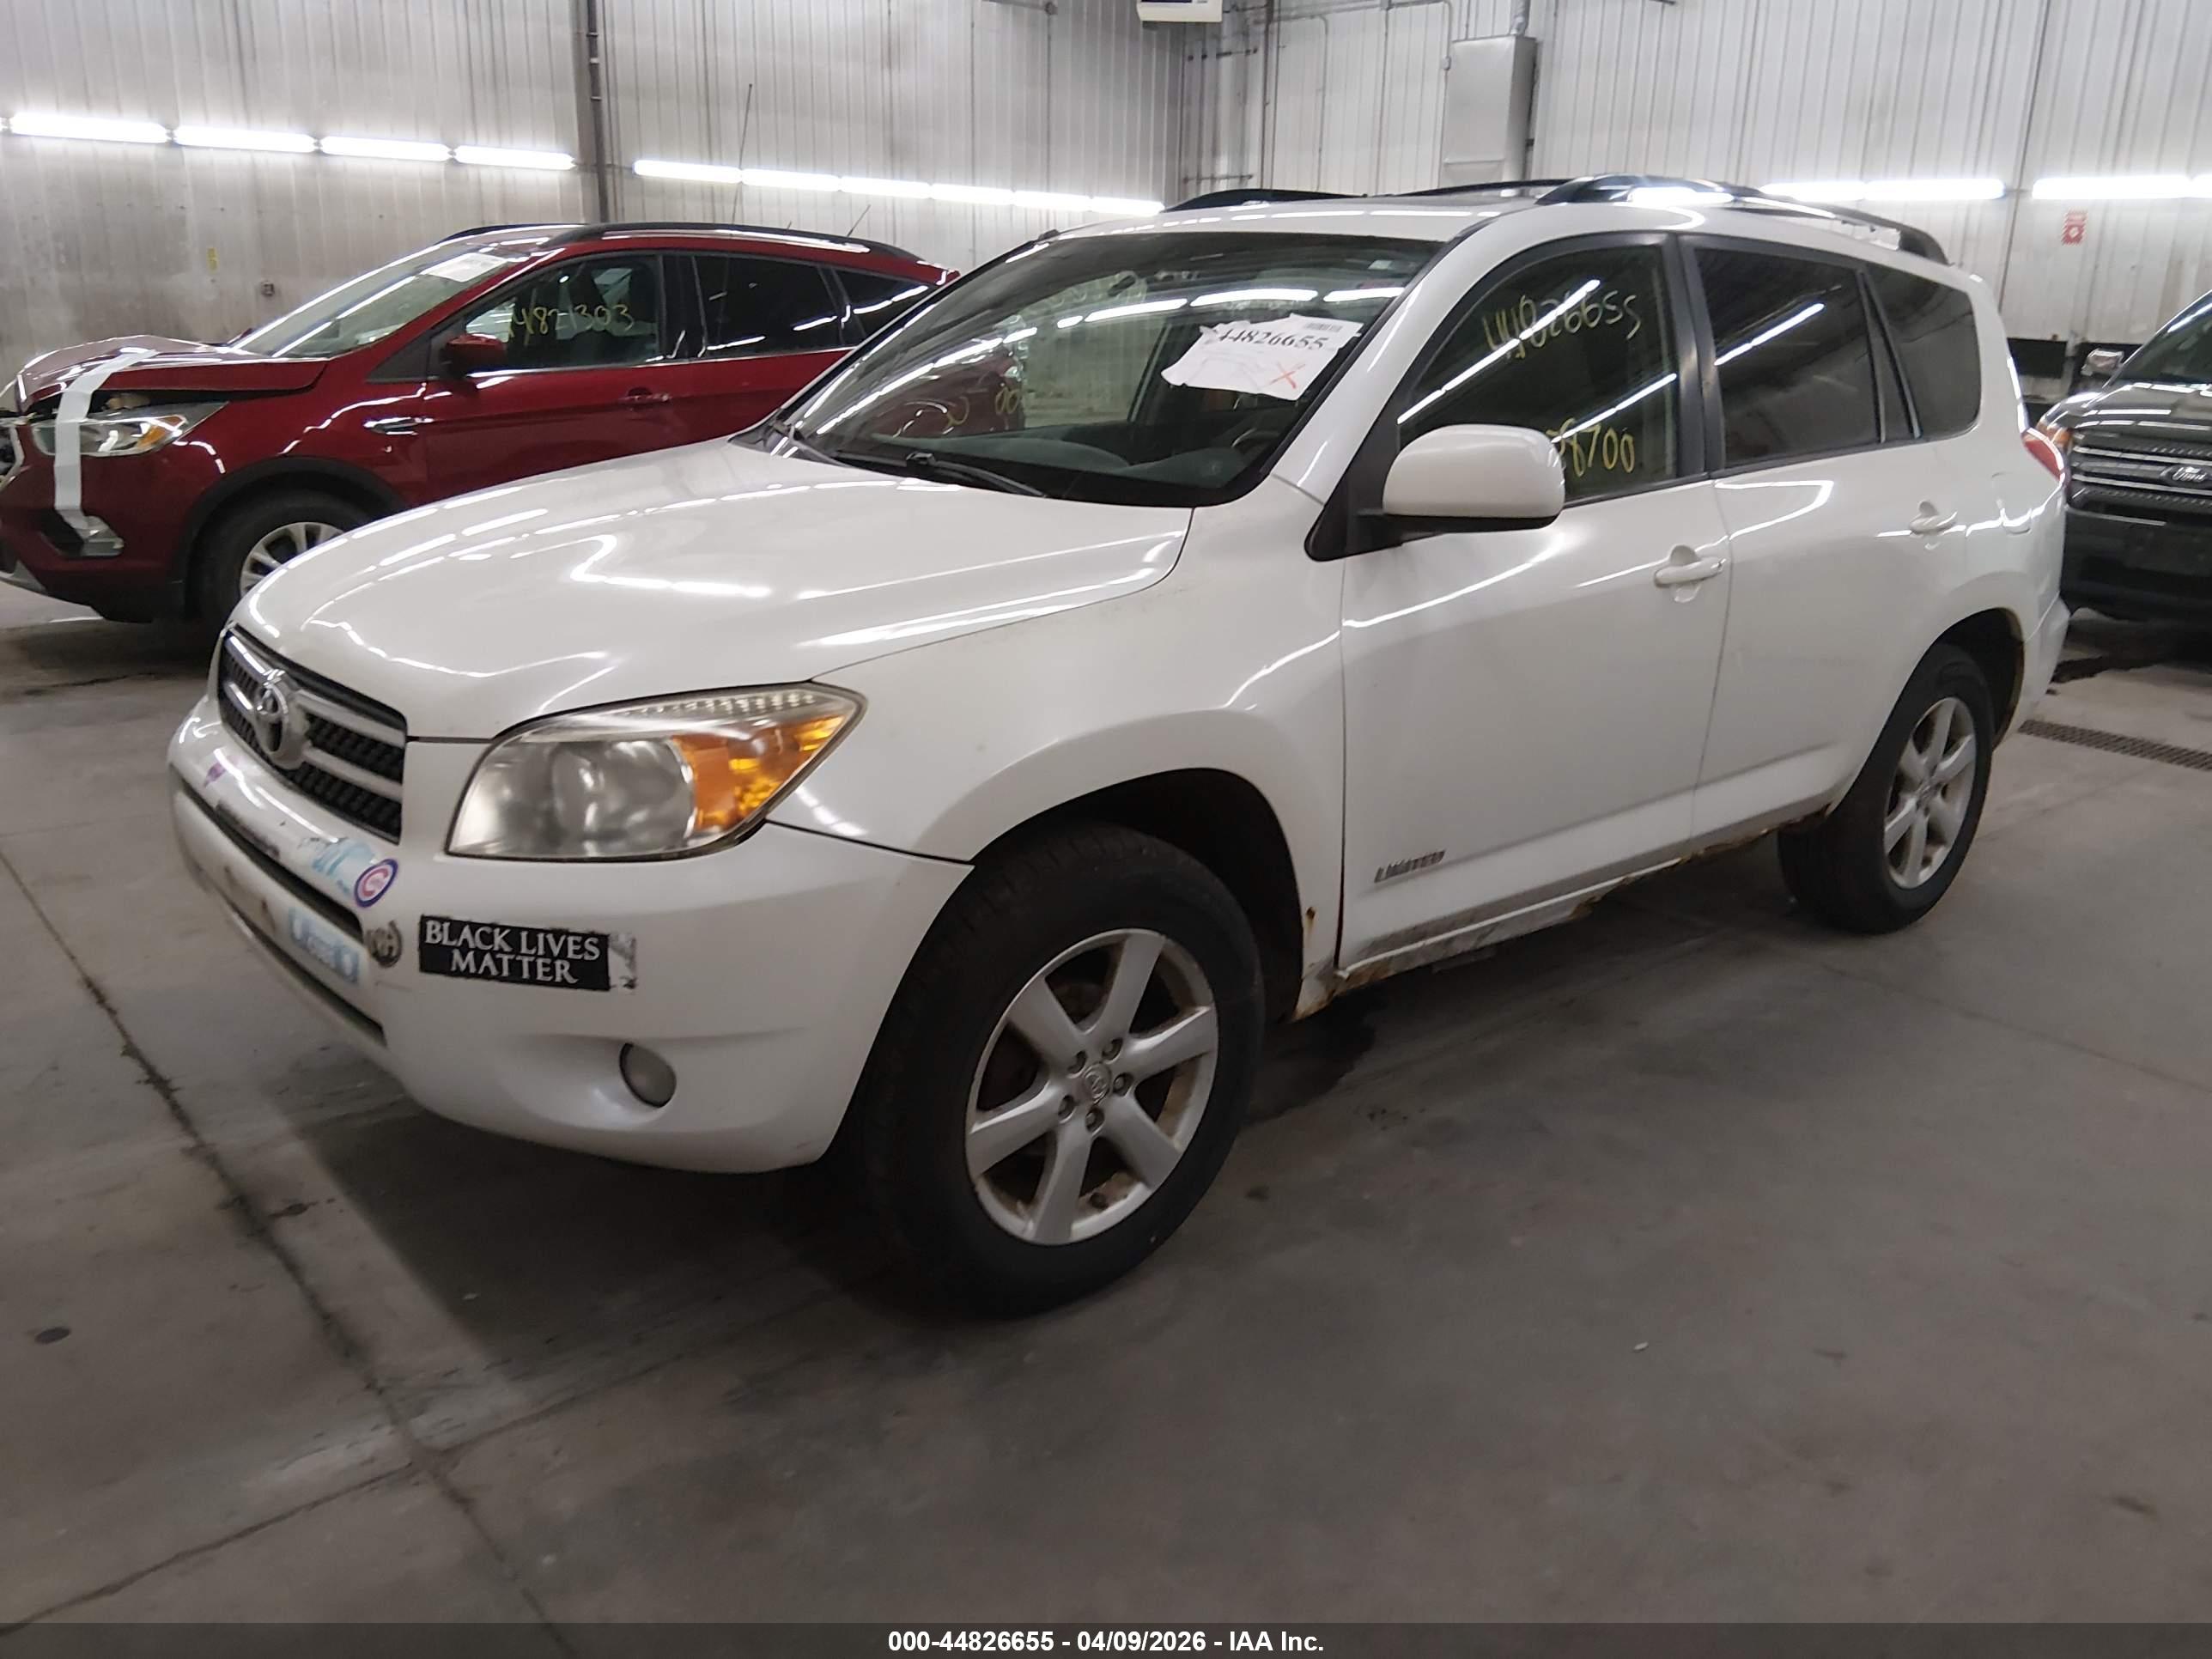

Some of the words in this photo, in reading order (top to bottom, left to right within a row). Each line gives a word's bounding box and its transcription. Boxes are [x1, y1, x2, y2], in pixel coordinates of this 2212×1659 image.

[425, 920, 513, 952] BLACK
[520, 931, 600, 961] LIVES
[451, 949, 579, 984] MATTER
